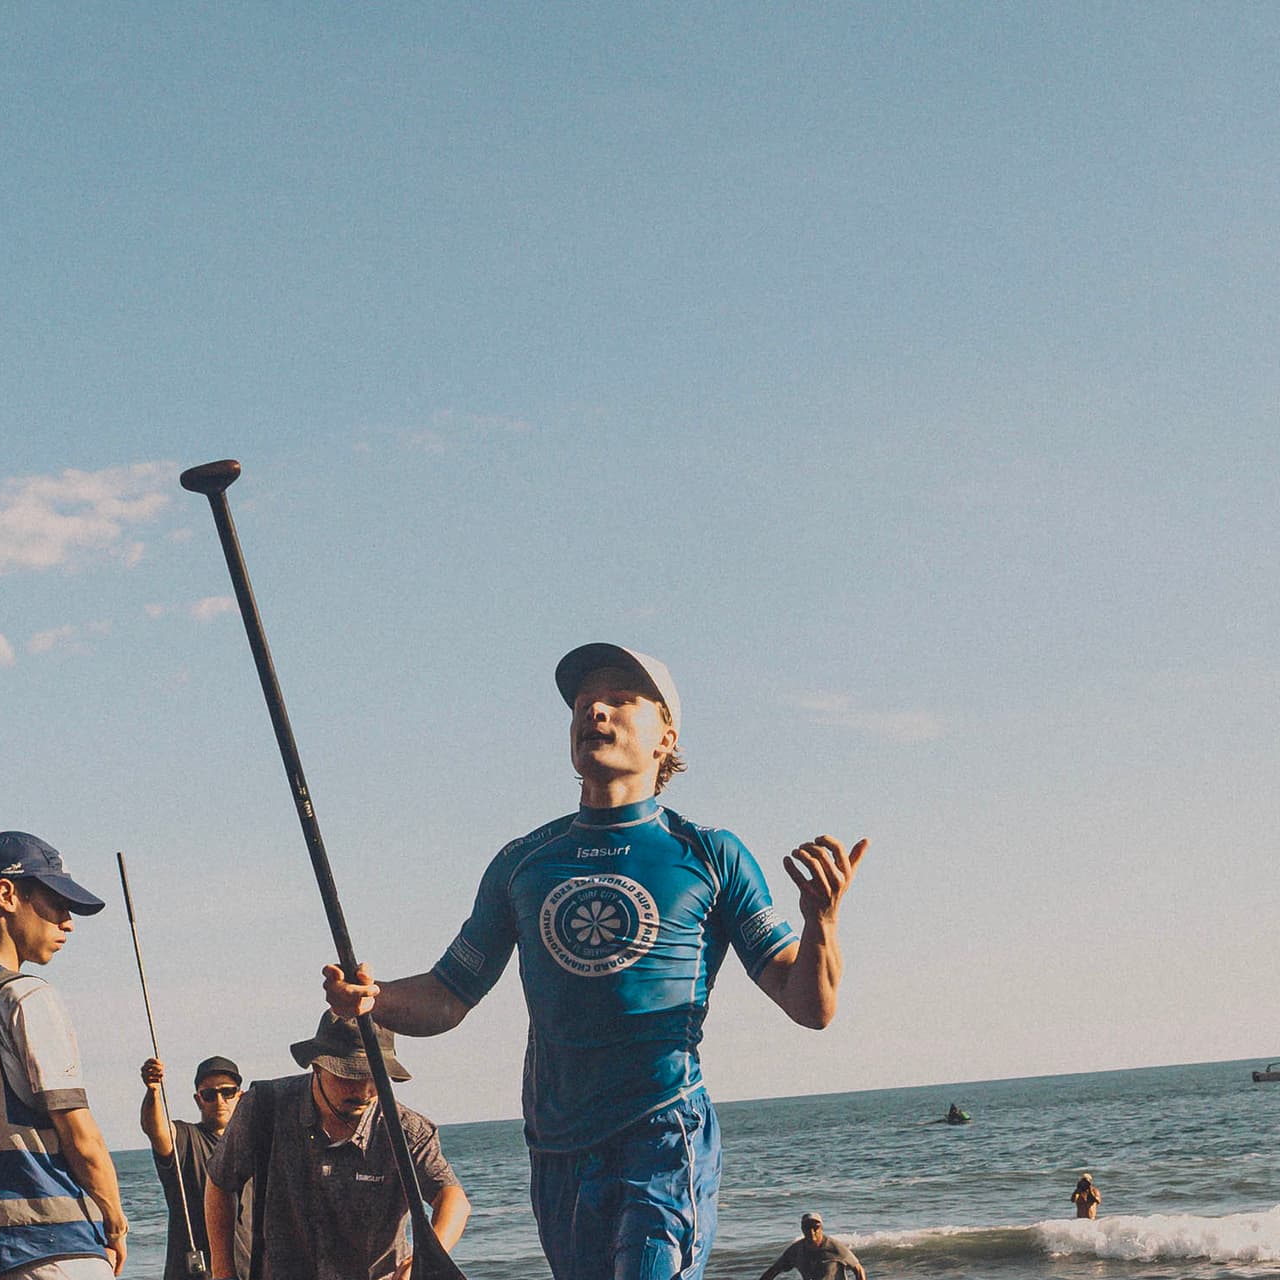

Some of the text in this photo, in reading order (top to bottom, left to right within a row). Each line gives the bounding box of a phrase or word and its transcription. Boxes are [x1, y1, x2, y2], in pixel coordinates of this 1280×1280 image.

[576, 845, 631, 859] isasurf
[598, 877, 636, 893] WORLD
[633, 891, 651, 910] SUP
